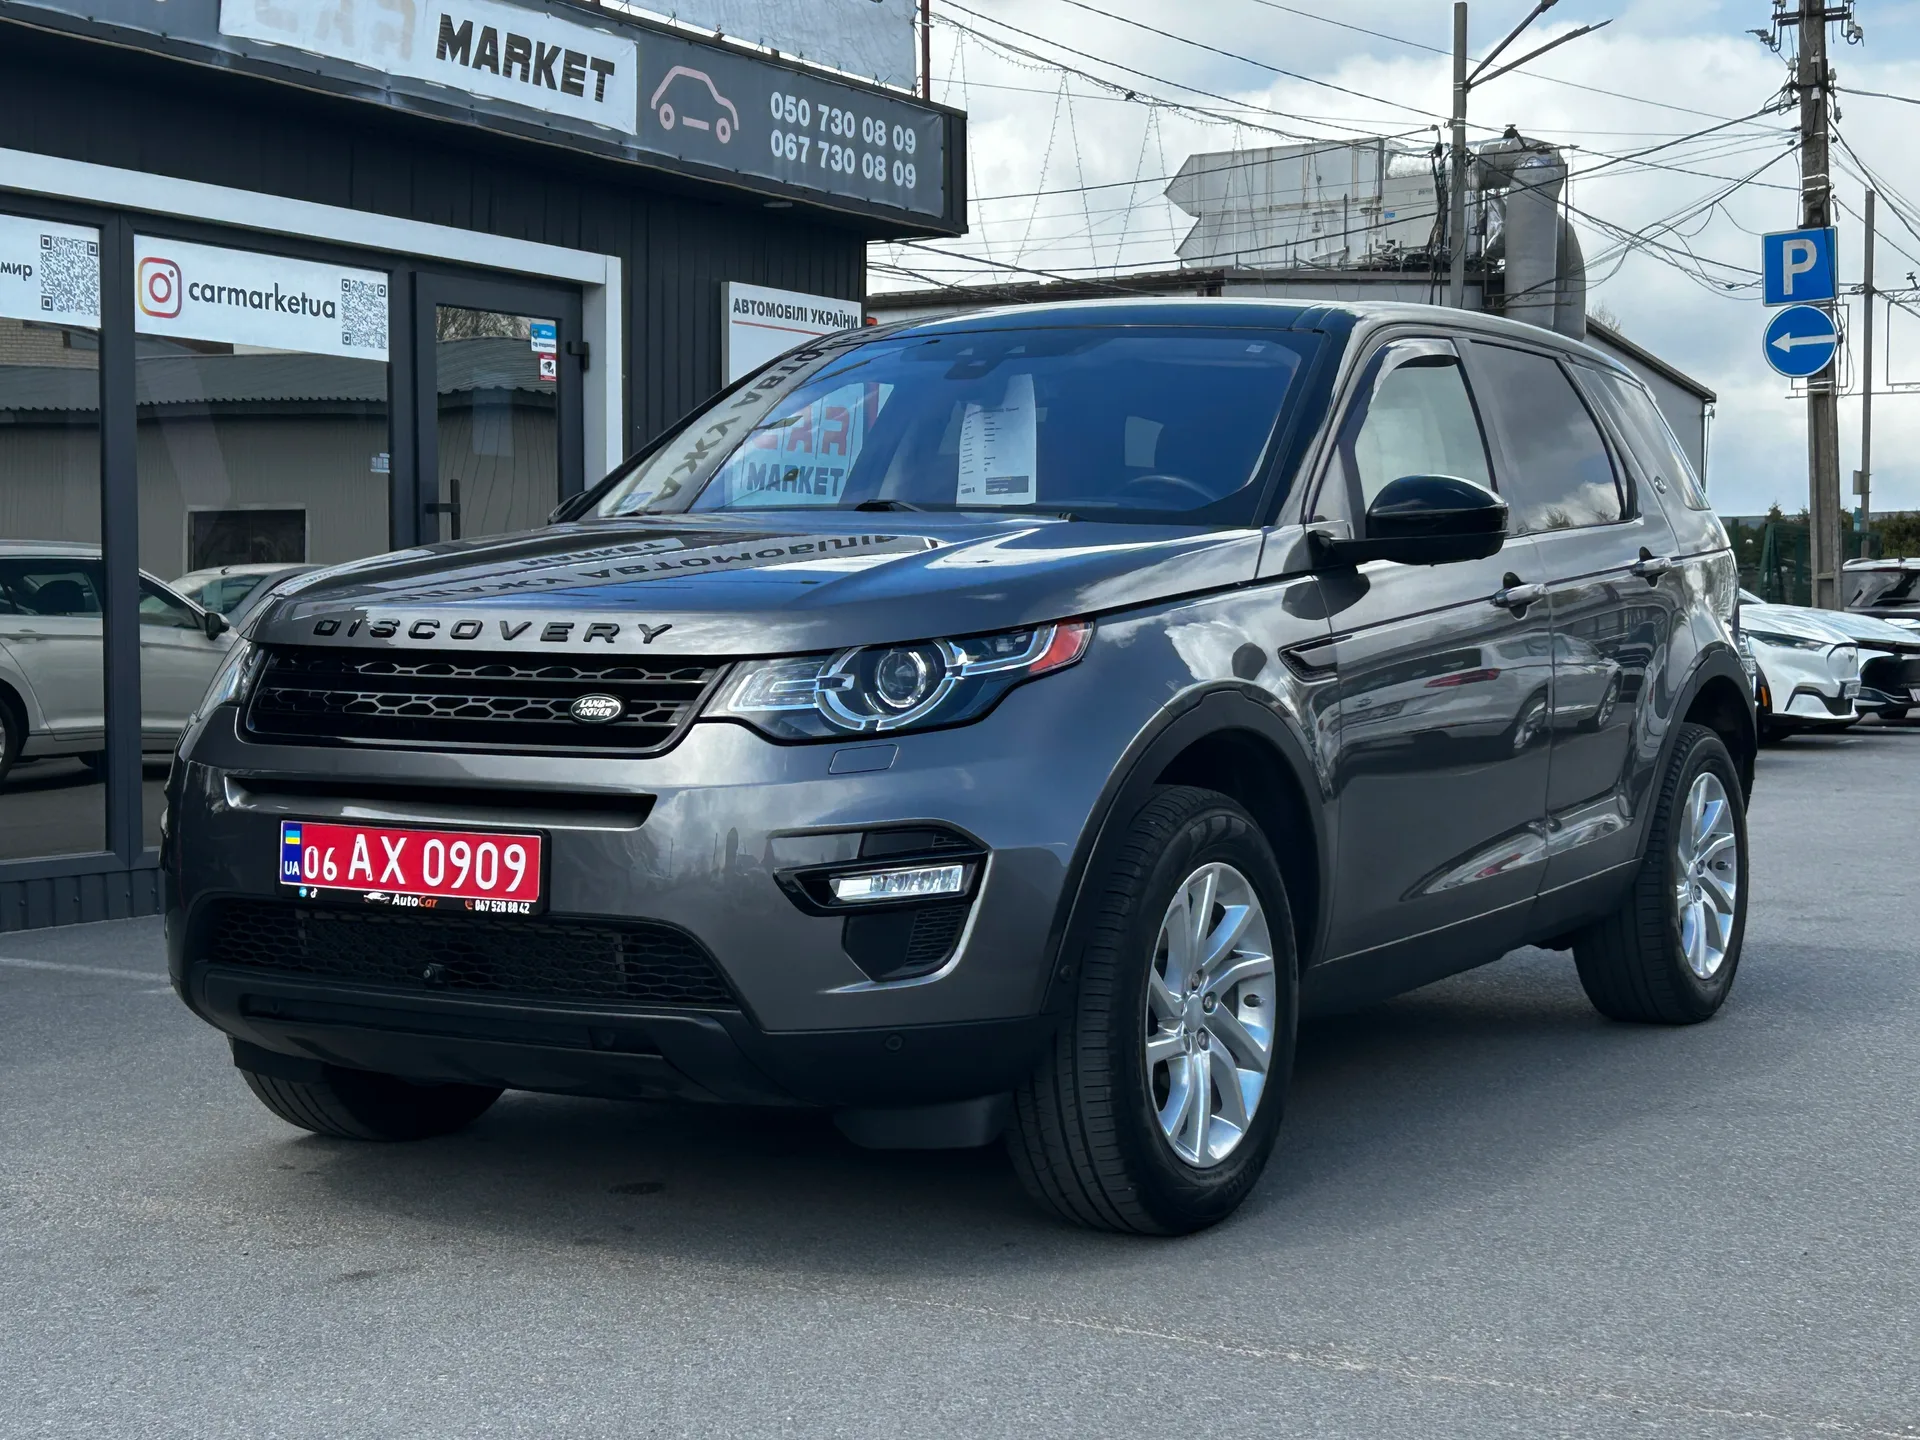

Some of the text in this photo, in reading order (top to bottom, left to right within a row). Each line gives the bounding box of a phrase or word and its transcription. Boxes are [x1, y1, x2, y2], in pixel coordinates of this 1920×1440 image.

[436, 13, 615, 103] MARKET
[770, 91, 916, 155] 050 730 08 09
[770, 129, 916, 189] 067 730 08 09
[0, 261, 33, 281] мир
[1783, 238, 1818, 296] P
[188, 282, 336, 320] carmarketua
[733, 297, 859, 329] АВТОМОБІЛІ УКРАЇНИ
[746, 461, 845, 497] MARKET
[313, 617, 674, 645] DISCOVERY
[580, 699, 606, 708] LAND
[580, 707, 612, 717] ROVER
[284, 833, 527, 892] UA 06 AX 0909
[392, 893, 439, 908] AutoCar
